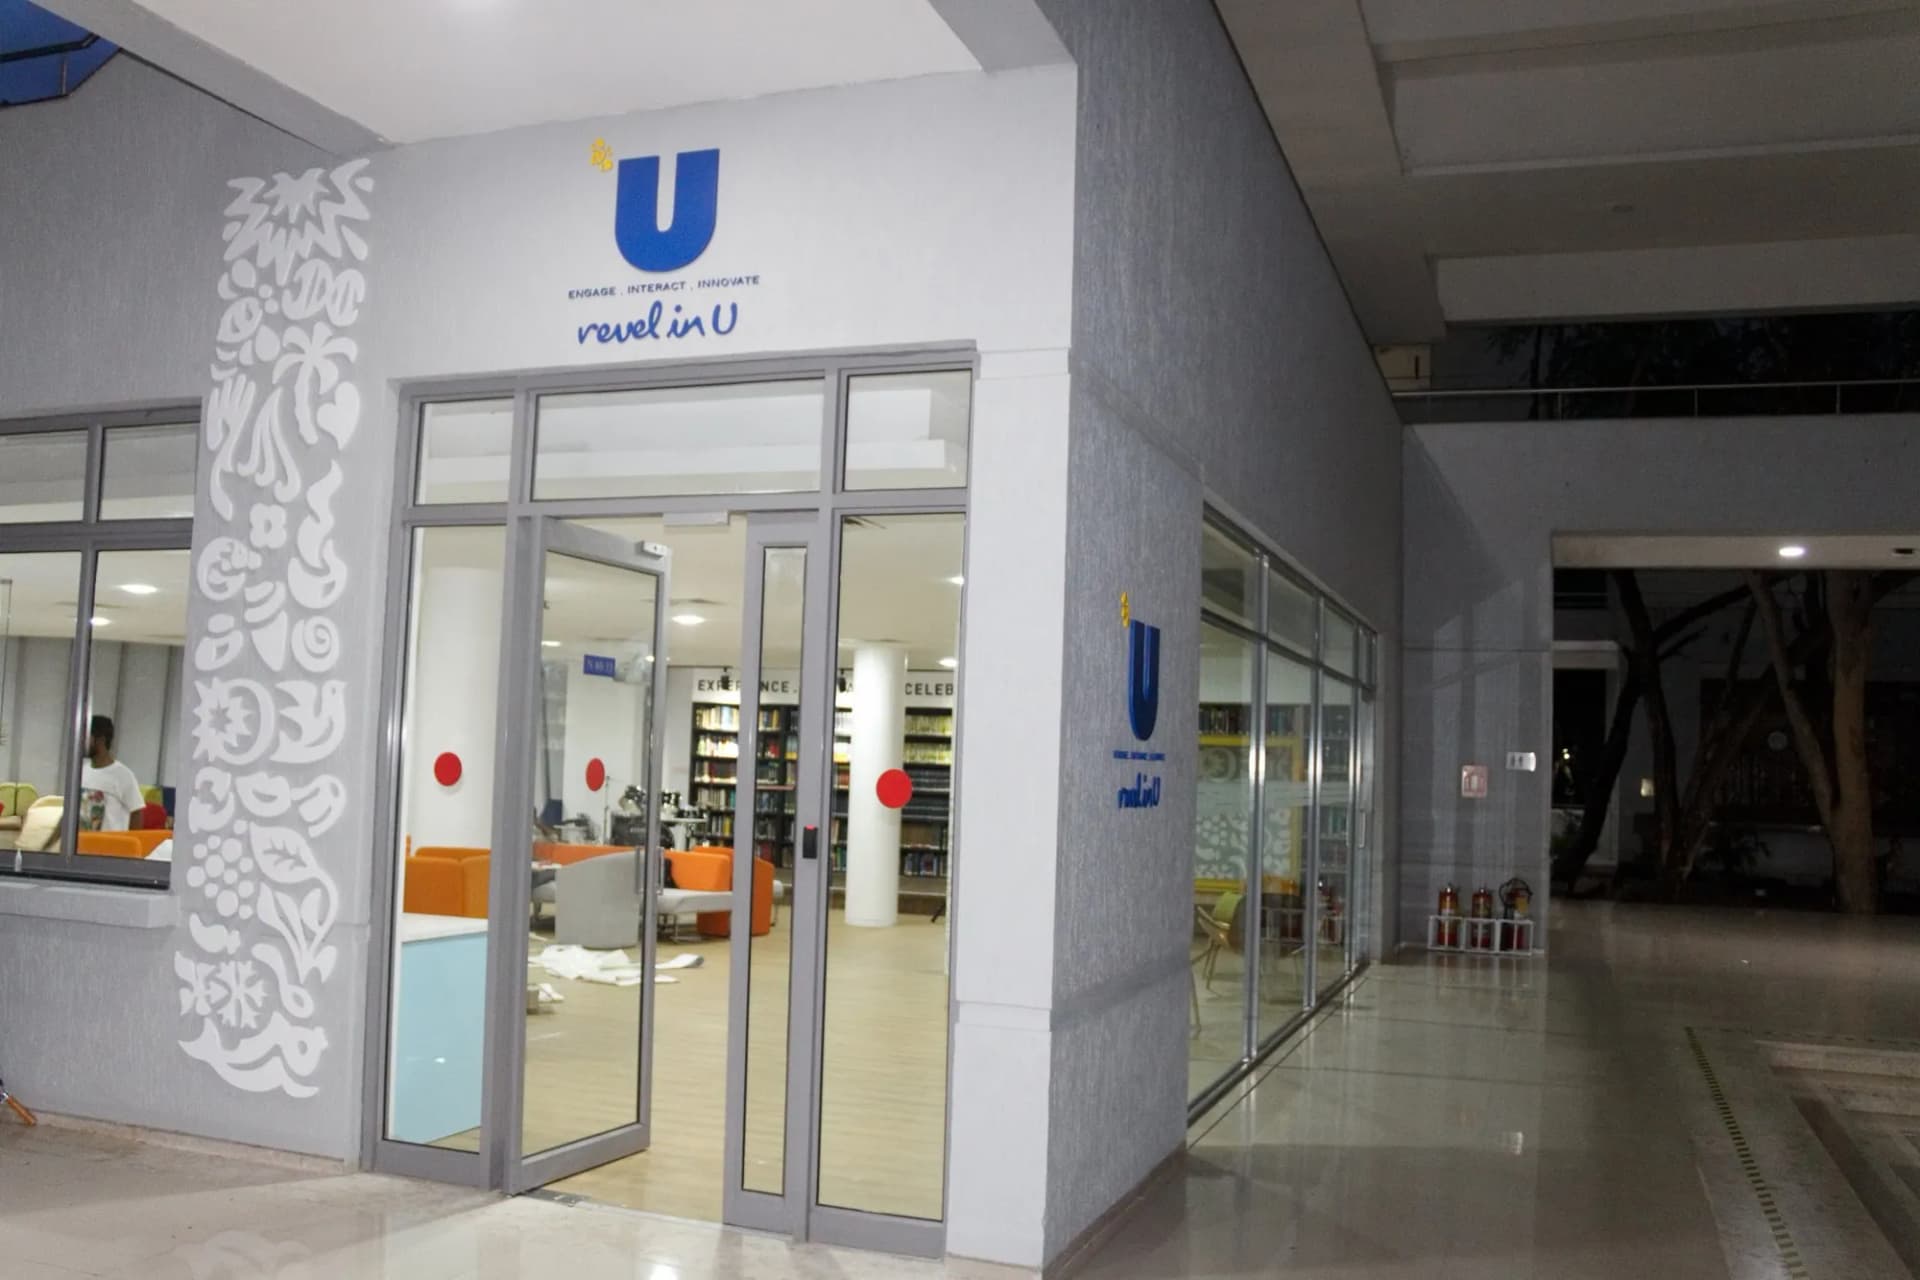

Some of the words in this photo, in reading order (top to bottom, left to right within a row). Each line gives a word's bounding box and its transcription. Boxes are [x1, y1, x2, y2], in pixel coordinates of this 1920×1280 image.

[615, 148, 720, 273] U
[568, 286, 617, 300] ENGAGE
[627, 280, 687, 295] INTERACT
[697, 274, 761, 289] INNOVATE
[577, 300, 663, 345] revel
[666, 304, 706, 338] in
[711, 301, 738, 336] U
